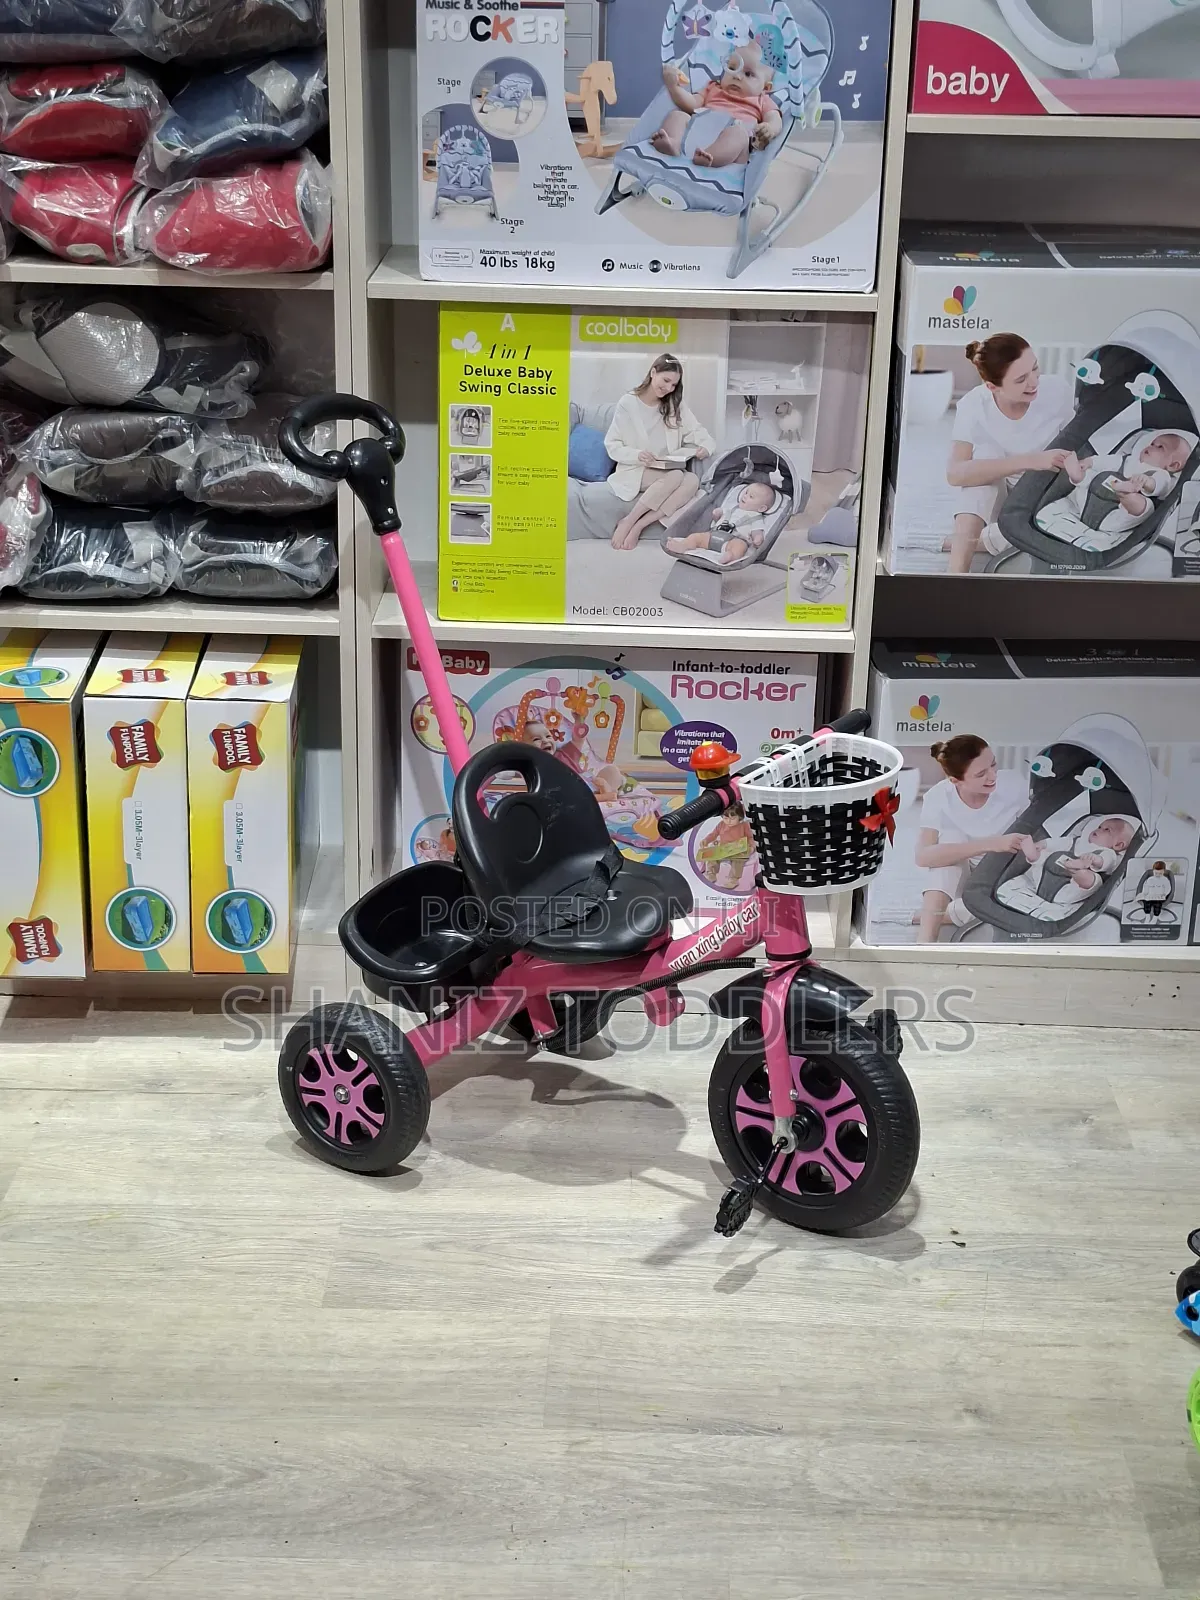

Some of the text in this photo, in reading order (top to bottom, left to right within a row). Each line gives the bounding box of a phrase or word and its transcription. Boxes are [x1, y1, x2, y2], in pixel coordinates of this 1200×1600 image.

[425, 0, 519, 11] Music & Soothe
[425, 14, 560, 44] ROCKER
[437, 77, 461, 87] Stage
[926, 65, 1009, 103] baby
[500, 218, 525, 226] Stage
[510, 226, 515, 234] 2
[480, 256, 497, 268] 40
[500, 256, 518, 268] lbs
[619, 262, 700, 271] Music Vibrations
[586, 317, 671, 342] coolbaby
[928, 316, 990, 329] mastela
[501, 344, 516, 359] in
[523, 345, 531, 360] 1
[463, 364, 553, 382] Deluxe Baby
[459, 380, 557, 397] Swing Classic
[572, 605, 664, 617] Model: CB02003
[672, 660, 791, 675] Infant-to-toddler
[670, 674, 807, 701] Rocker
[674, 729, 709, 737] Vibrations
[896, 721, 952, 732] mastela
[119, 728, 135, 764] FUNPOOL
[131, 725, 150, 762] FAMILY
[221, 730, 236, 766] FUNPOOL
[233, 727, 252, 764] FAMILY
[696, 938, 720, 957] xing
[715, 916, 743, 941] baby
[741, 903, 758, 923] car
[19, 924, 40, 959] FAMILY
[35, 923, 51, 956] FUNPOOL
